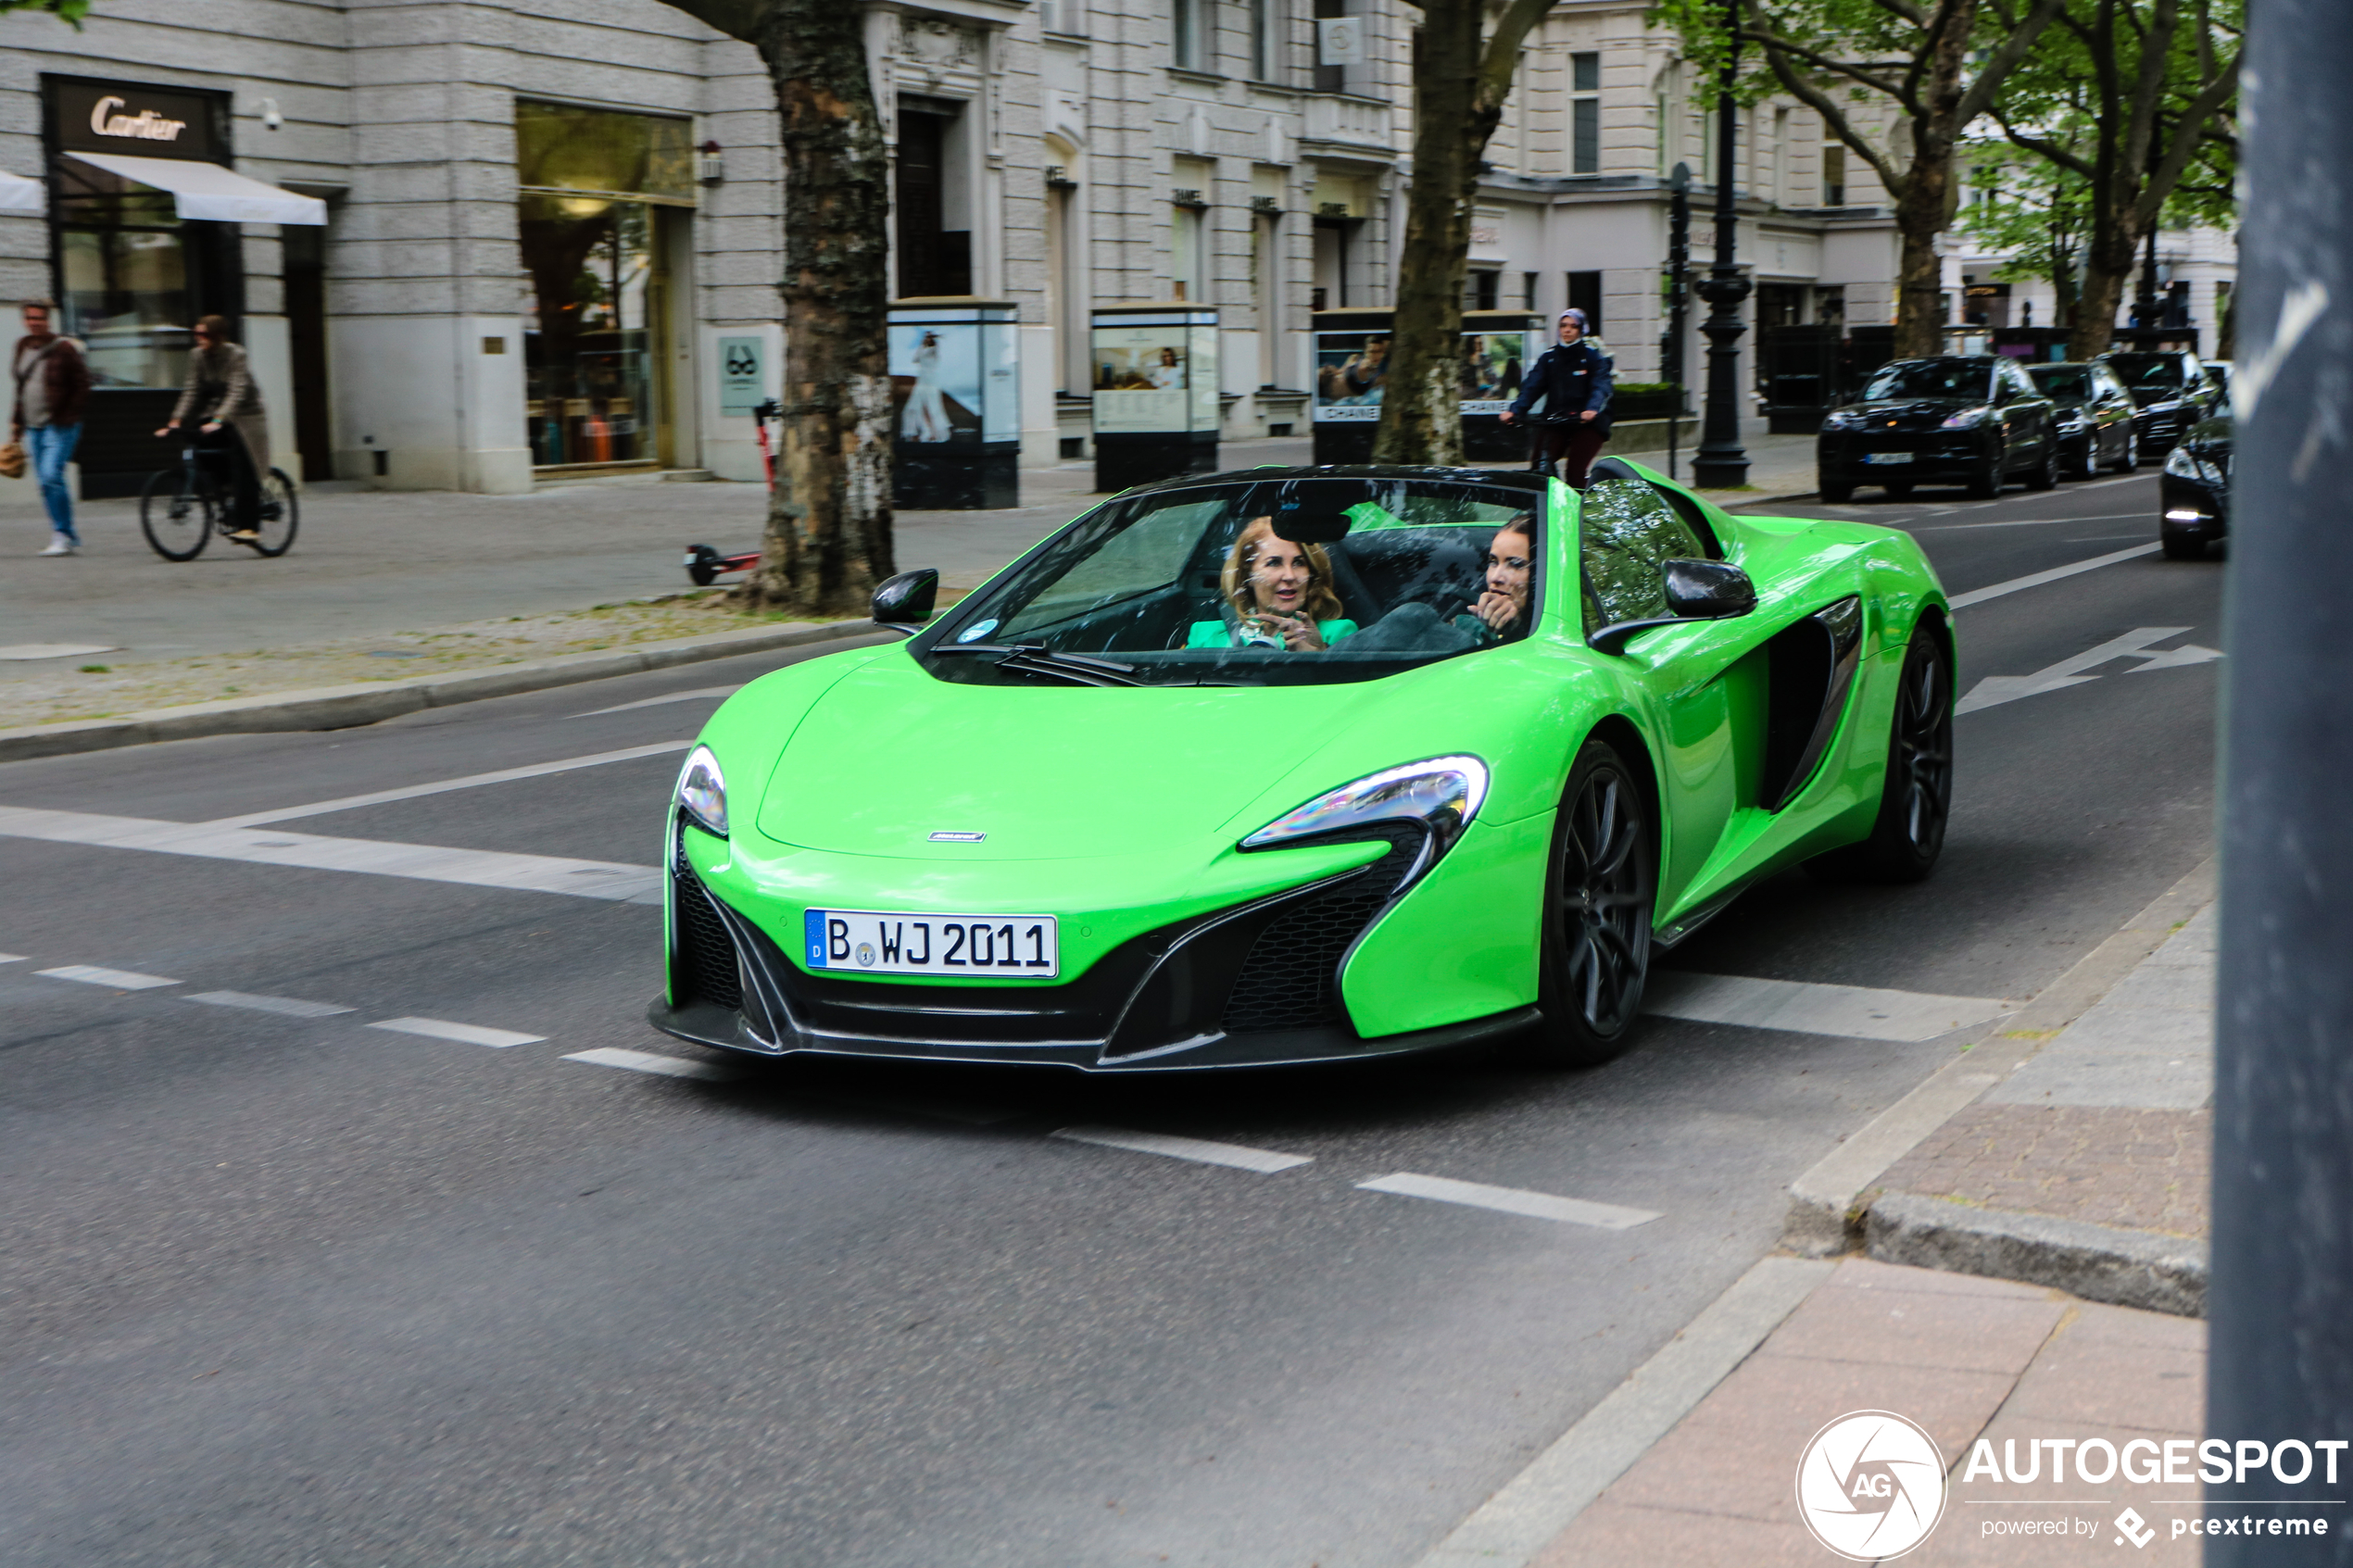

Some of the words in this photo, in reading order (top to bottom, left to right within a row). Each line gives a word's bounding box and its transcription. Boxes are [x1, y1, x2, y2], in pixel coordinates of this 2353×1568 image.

[91, 95, 186, 141] Cartier
[1326, 408, 1378, 419] CHANE
[1458, 402, 1508, 413] CHANE
[828, 918, 851, 961] B
[879, 921, 930, 965] WJ
[943, 923, 1051, 968] 2011
[812, 945, 822, 959] D
